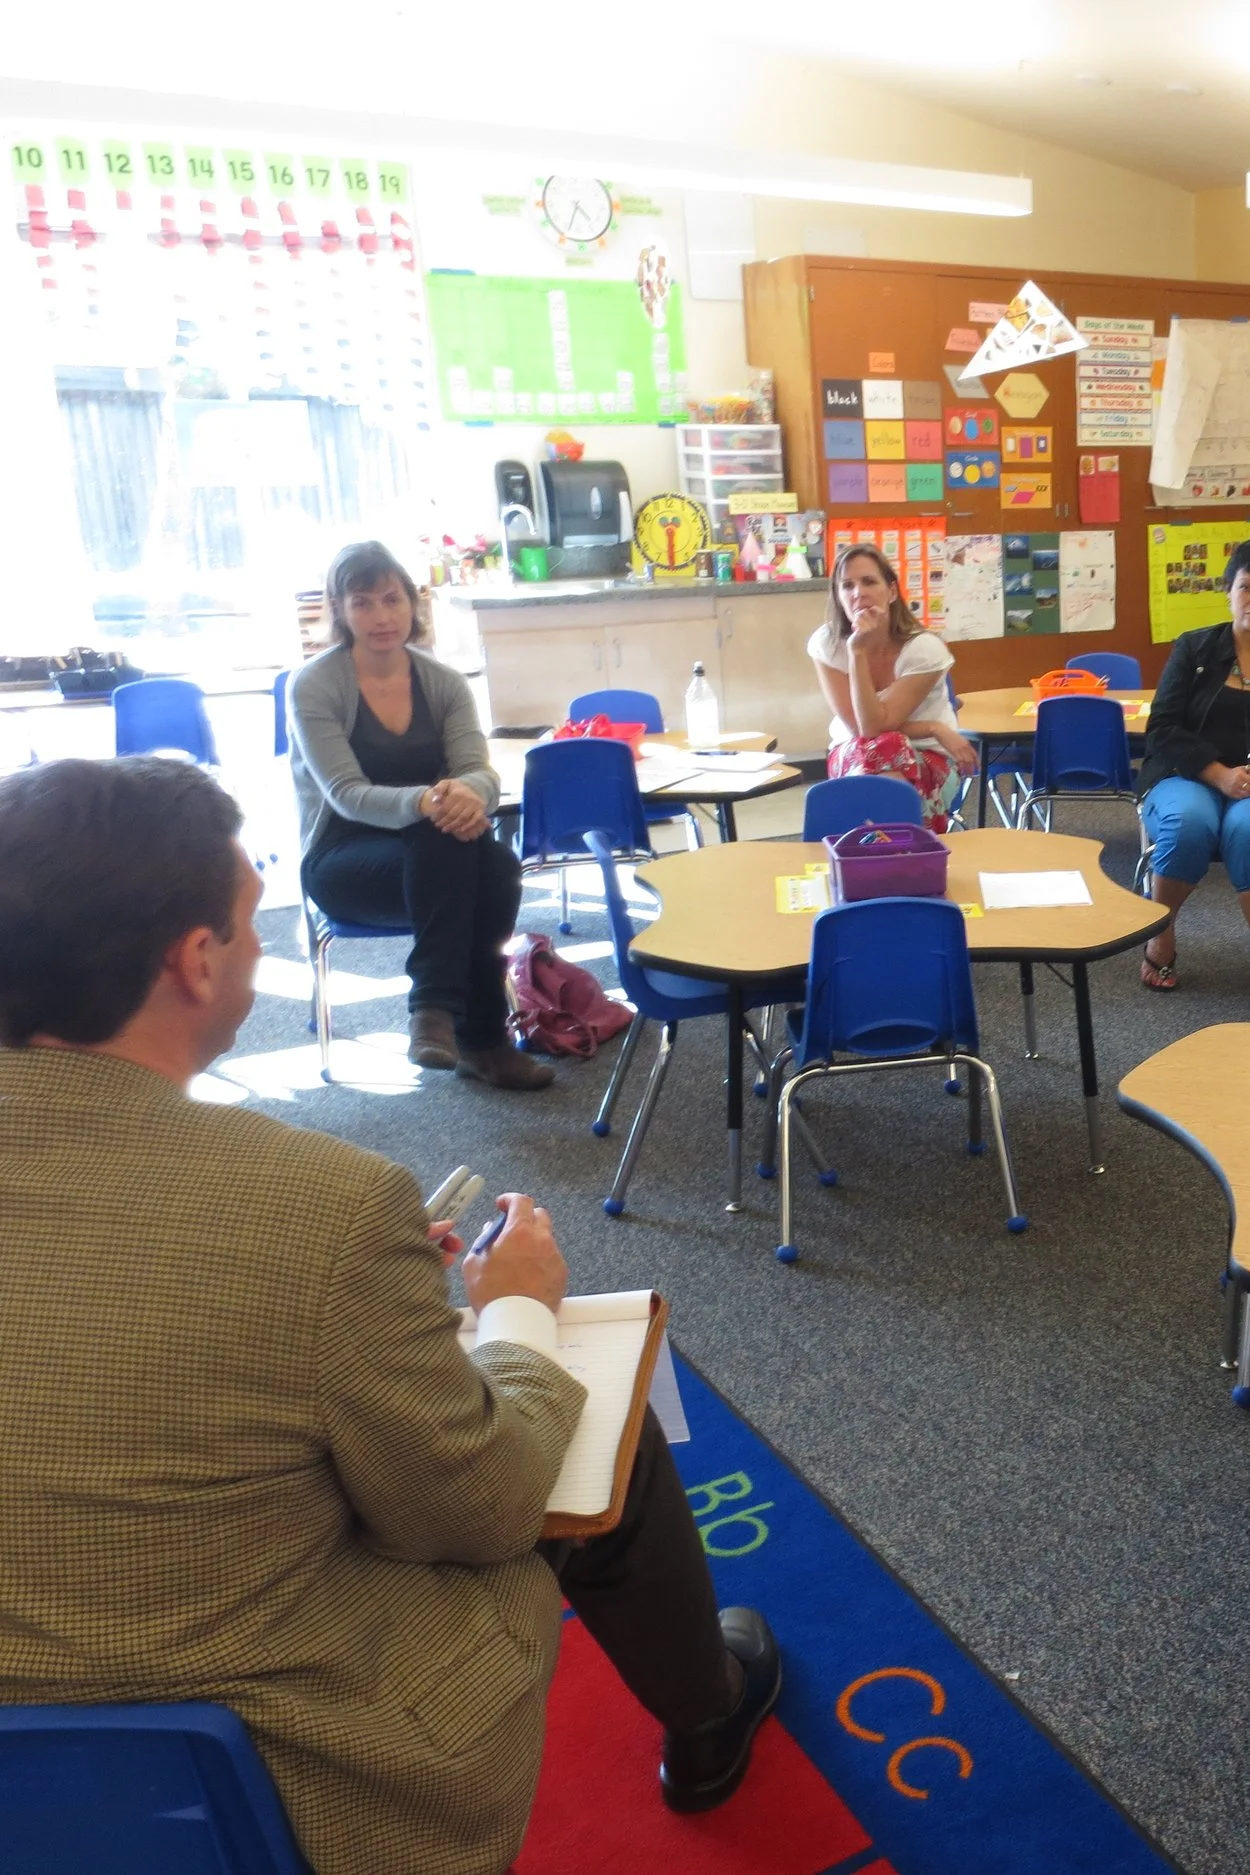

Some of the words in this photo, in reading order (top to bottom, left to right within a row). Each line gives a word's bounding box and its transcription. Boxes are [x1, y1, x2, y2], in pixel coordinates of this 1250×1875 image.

[14, 146, 43, 168] 10
[62, 149, 86, 171] 11
[104, 152, 132, 174] 12
[148, 154, 174, 175] 13
[188, 157, 215, 179] 14
[229, 160, 255, 182] 15
[268, 164, 294, 186] 16
[305, 167, 330, 188] 17
[344, 170, 369, 191] 18
[379, 174, 401, 195] 19
[1102, 335, 1129, 345] Sunday
[1102, 350, 1131, 361] Monday
[1102, 366, 1131, 377] Tuesday
[1096, 383, 1137, 393] Wednesday
[826, 388, 859, 406] black
[868, 390, 898, 406] white
[1101, 398, 1134, 408] Thursday
[1104, 413, 1128, 424] Friday
[871, 429, 902, 449] yellow
[911, 430, 933, 449] red
[1099, 428, 1134, 439] Saturday
[910, 475, 936, 491] green
[834, 1666, 973, 1799] Cc
